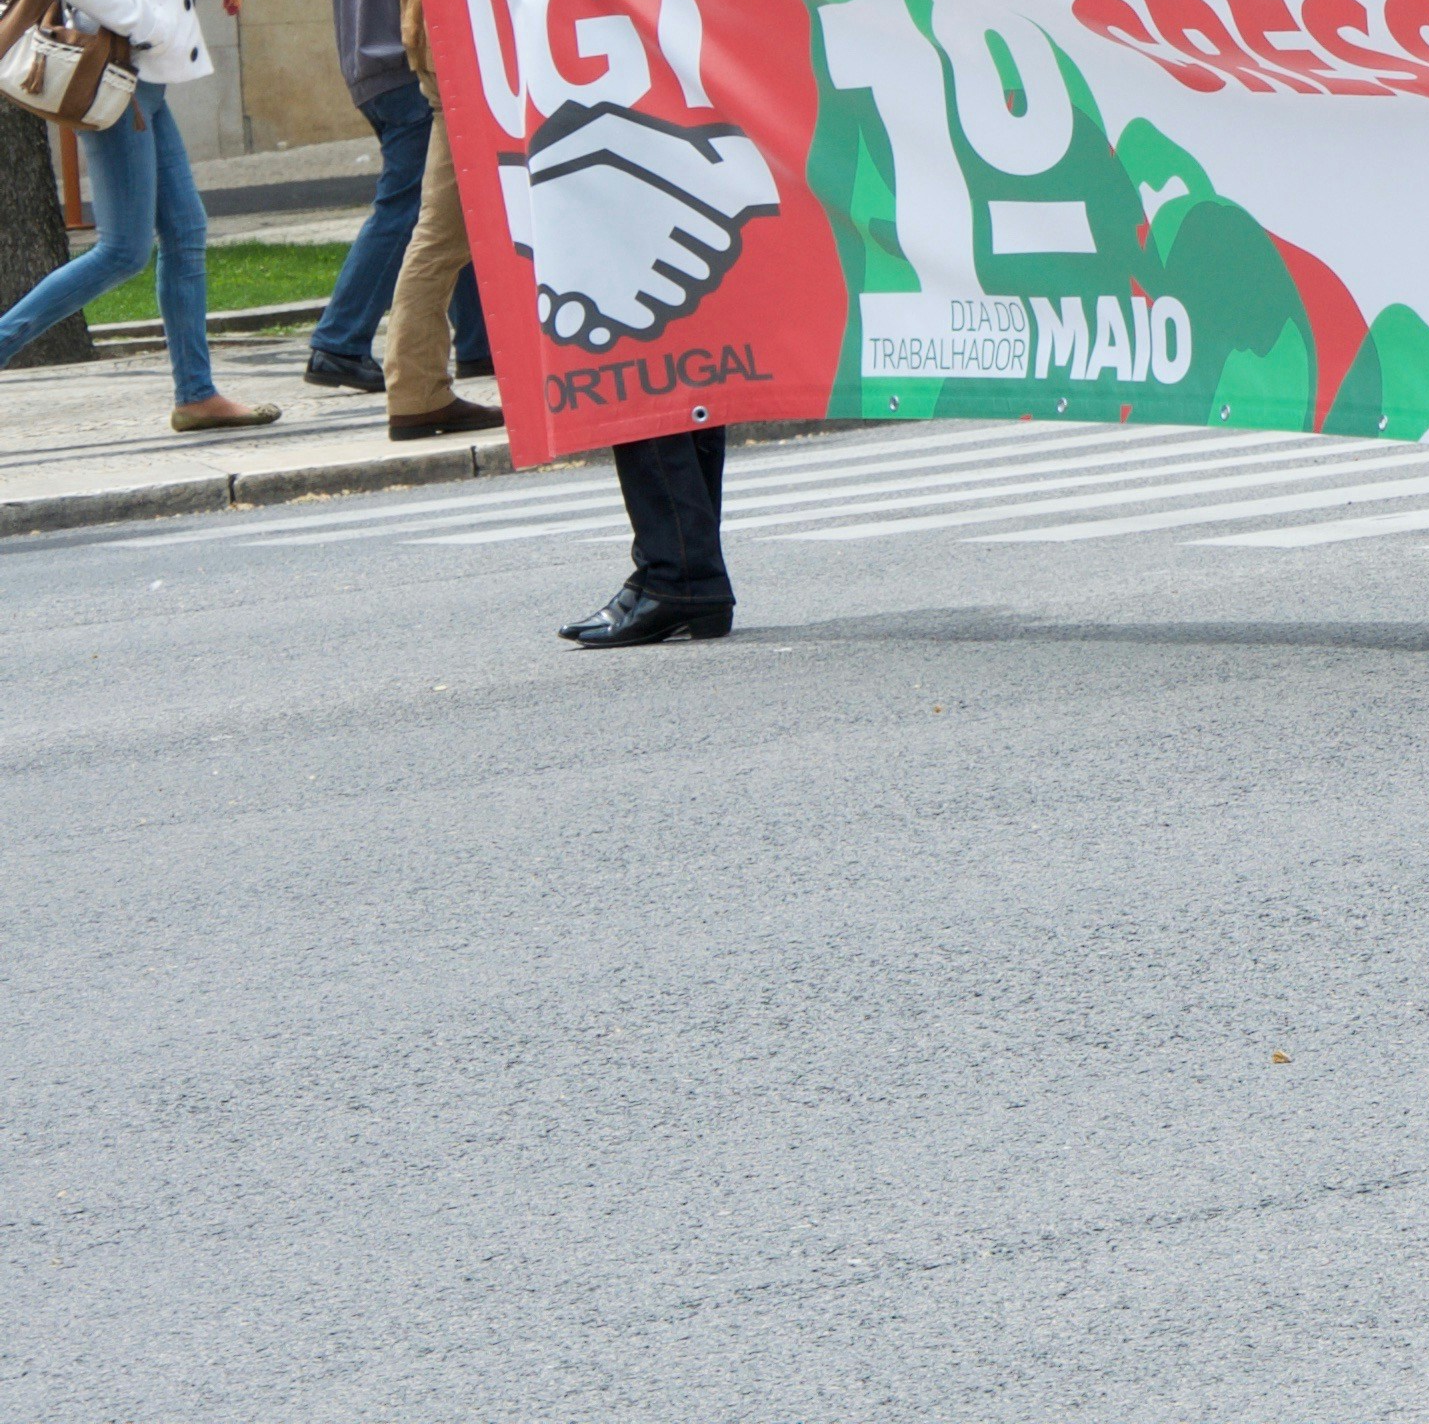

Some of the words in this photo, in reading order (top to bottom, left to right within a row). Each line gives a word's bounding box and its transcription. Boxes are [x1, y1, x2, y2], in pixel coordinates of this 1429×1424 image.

[950, 300, 993, 332] DIA
[998, 302, 1026, 332] DO
[1029, 295, 1192, 384] MAIO
[544, 342, 773, 414] ORTUGAL
[870, 338, 1026, 372] TRABALHADOR
